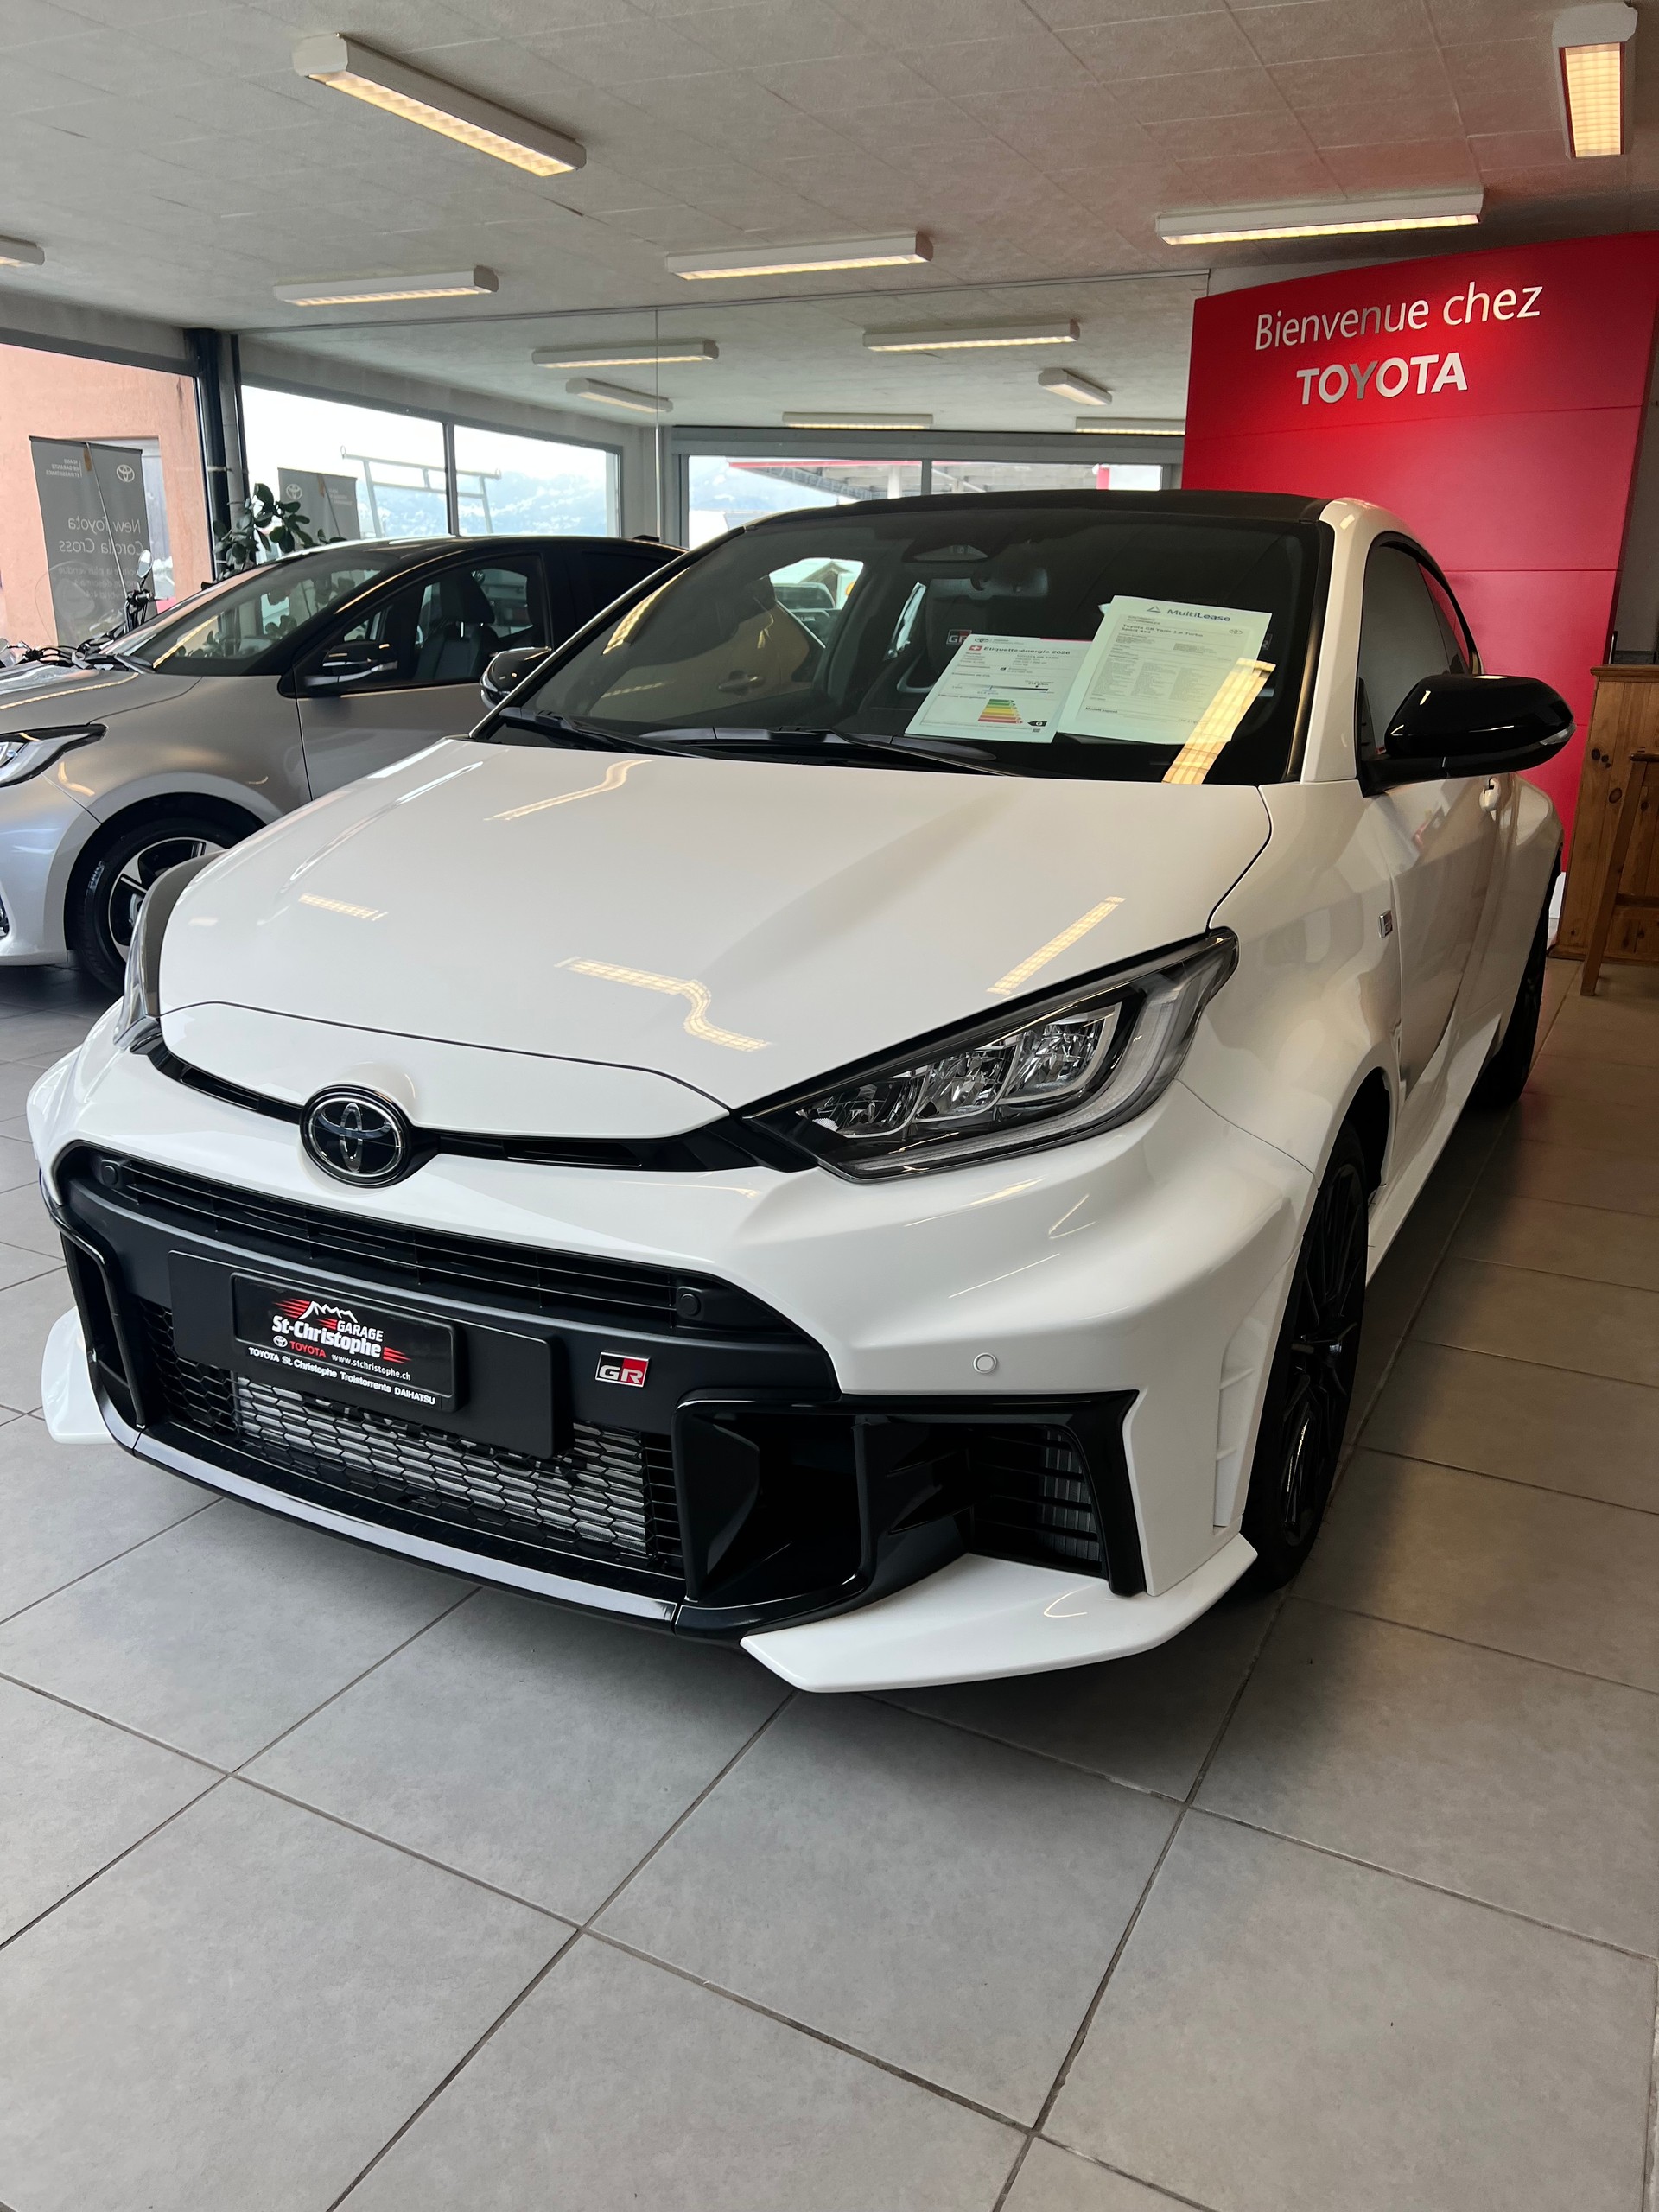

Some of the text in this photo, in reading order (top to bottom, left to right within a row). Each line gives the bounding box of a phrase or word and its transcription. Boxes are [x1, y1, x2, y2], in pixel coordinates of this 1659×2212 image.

[1255, 282, 1543, 351] Bienvenue chez
[1296, 352, 1468, 405] TOYOTA
[1167, 609, 1231, 622] MultiLease
[271, 1315, 382, 1358] St-Christophe
[337, 1319, 384, 1342] GARAGE
[289, 1340, 327, 1358] TOYOTA
[248, 1346, 280, 1363] TOYOTA
[293, 1358, 338, 1378] Christophe
[340, 1370, 391, 1393] Troistorrents
[394, 1386, 435, 1406] DAIHATSU
[331, 1353, 411, 1381] www.stchristophe.ch
[599, 1364, 644, 1384] GR
